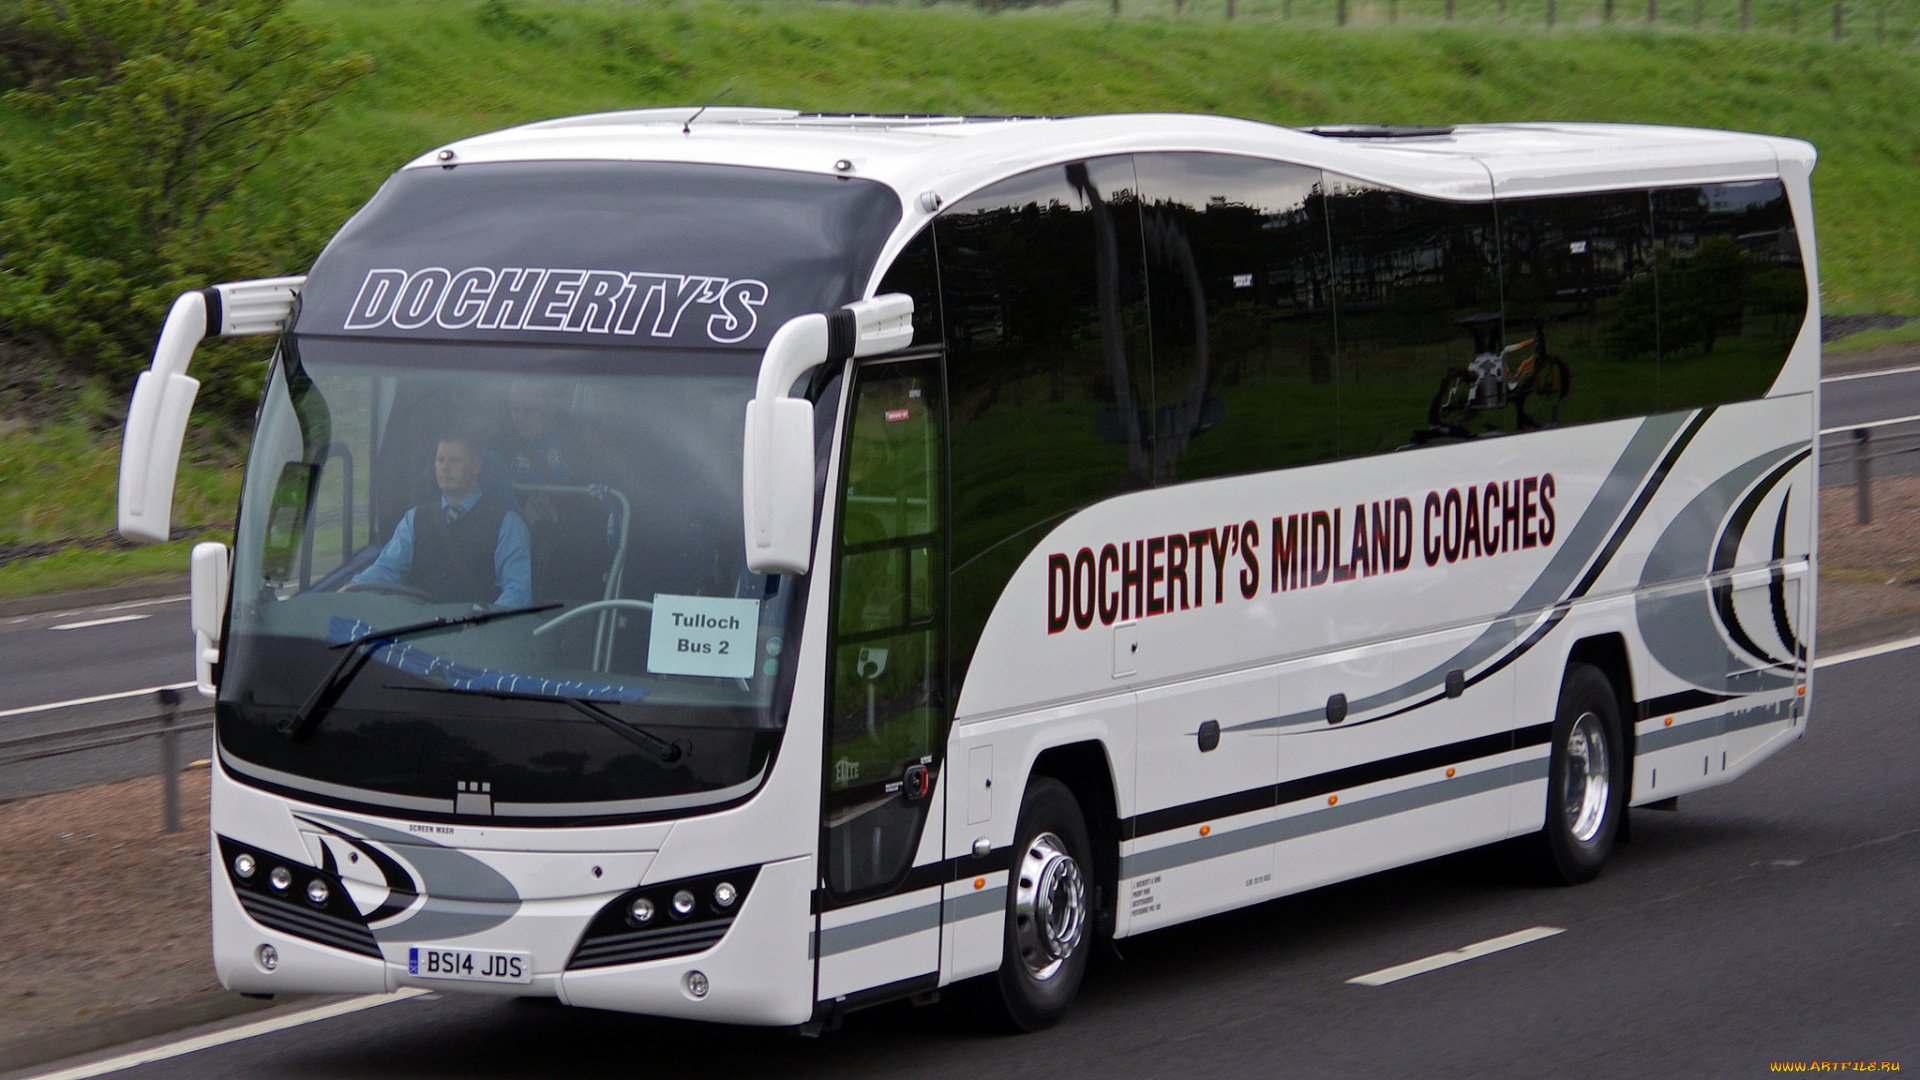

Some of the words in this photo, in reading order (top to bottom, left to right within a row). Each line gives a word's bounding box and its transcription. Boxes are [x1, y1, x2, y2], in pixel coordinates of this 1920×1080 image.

[343, 266, 769, 344] DOCHERTY'S
[1047, 519, 1260, 635] DOCHERTY'S
[1270, 496, 1413, 595] MIDLAND
[1422, 472, 1557, 568] COACHES
[671, 612, 740, 630] Tulloch
[677, 638, 712, 654] Bus
[718, 640, 730, 655] 2
[408, 824, 434, 834] SCREEN
[435, 826, 455, 836] WASH
[427, 951, 474, 975] BS14
[481, 955, 522, 978] JDS
